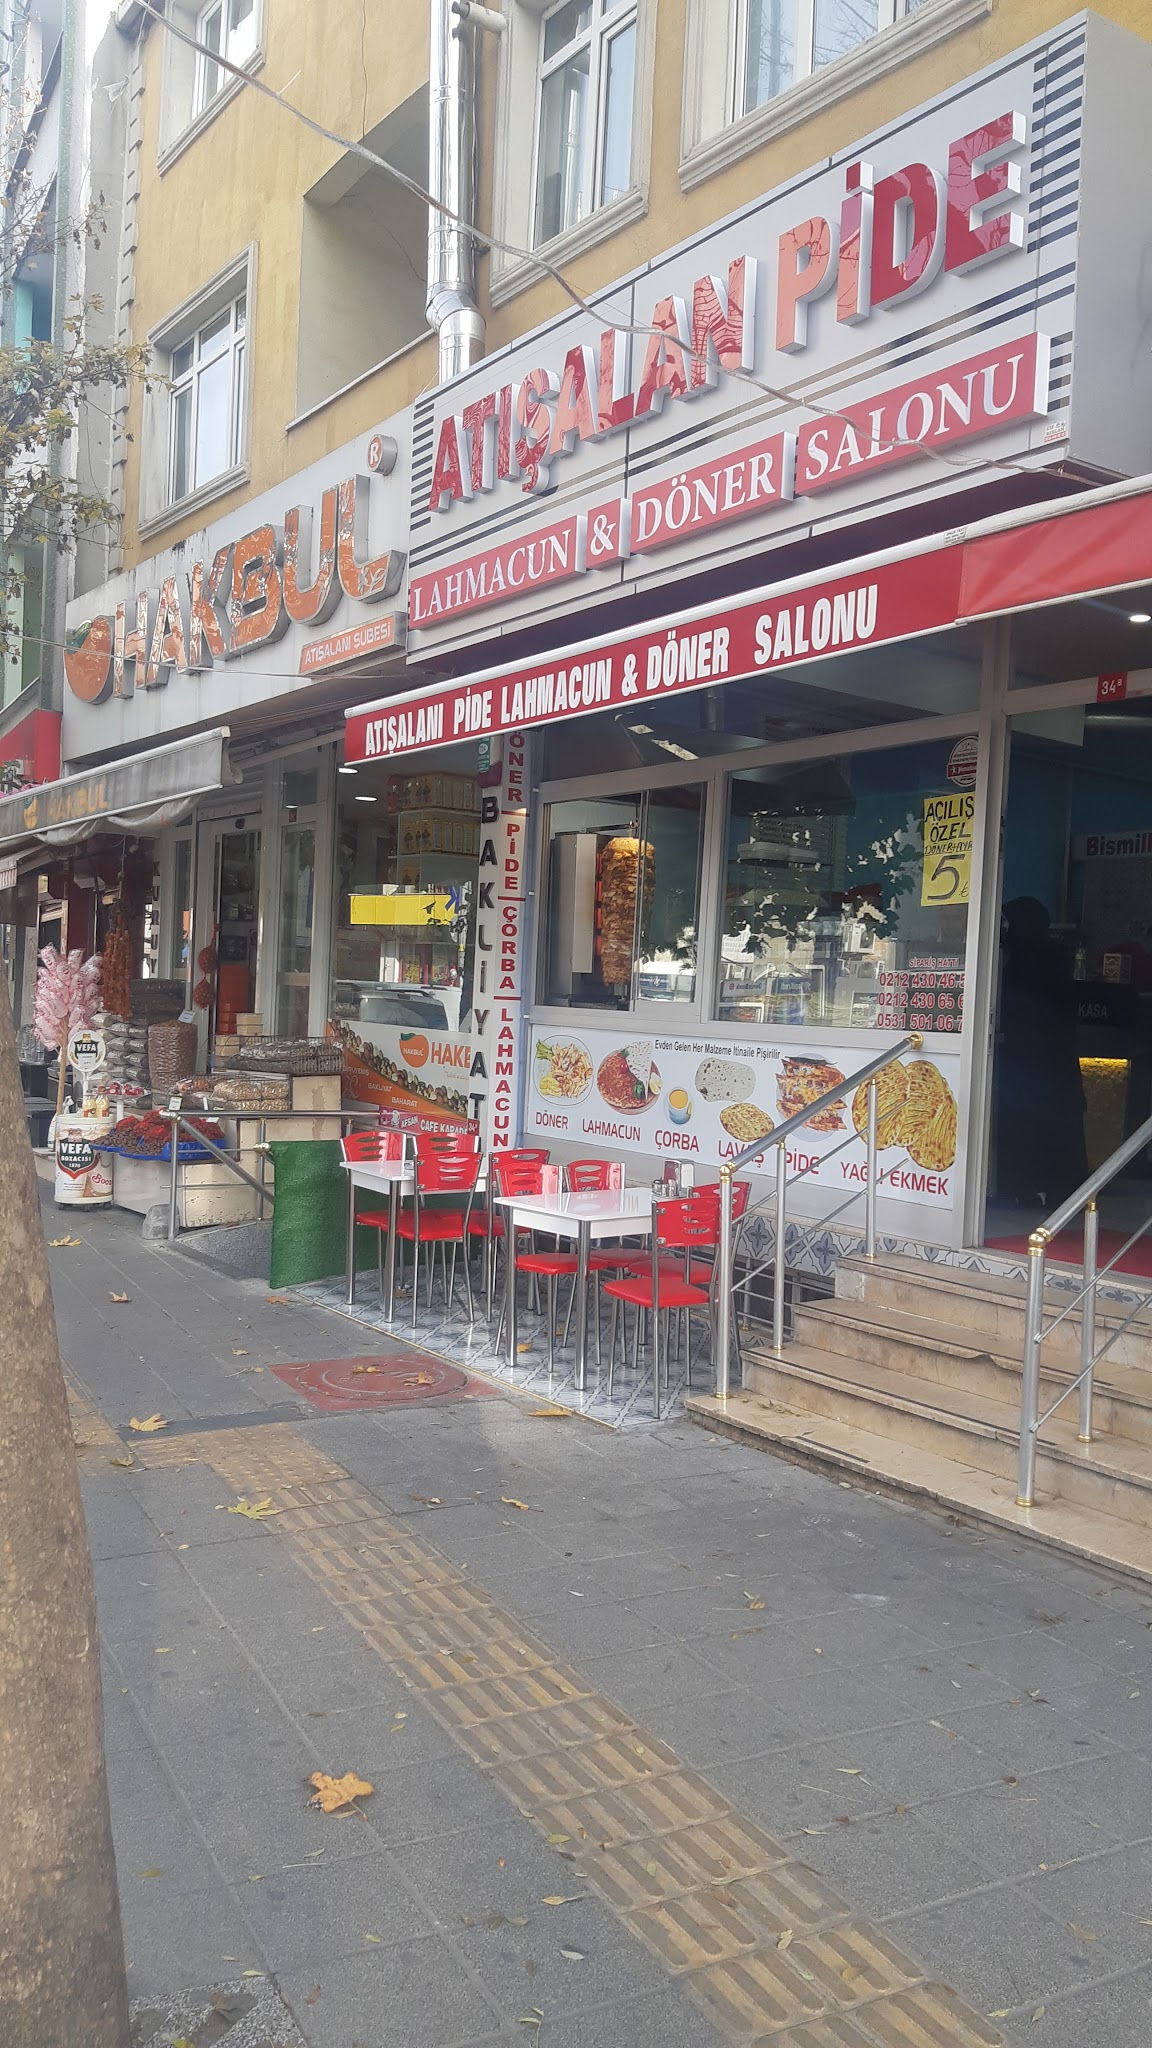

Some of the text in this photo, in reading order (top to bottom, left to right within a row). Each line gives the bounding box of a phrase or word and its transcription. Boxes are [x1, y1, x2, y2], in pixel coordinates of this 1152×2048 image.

[428, 110, 1026, 512] ATIŞALAN PİDE
[413, 354, 1025, 621] LAHMACUN & DÖNER SALONU
[113, 474, 405, 699] HAKBUL
[304, 635, 352, 665] ATIŞALANI
[365, 703, 444, 756] ATIŞALANI
[453, 687, 494, 735] PİDE
[501, 658, 612, 724] LAHMACUN
[621, 655, 639, 694] &
[646, 626, 730, 691] DÖNER
[754, 584, 878, 665] SALONU
[925, 796, 974, 822] AÇILIŞ
[929, 821, 972, 843] ÖZEL
[504, 823, 521, 890] PİDE
[927, 854, 965, 900] 5
[469, 796, 500, 1119] BAKLİYAT
[500, 906, 518, 990] ÇORBA
[909, 956, 936, 969] SİPARİŞ
[879, 972, 909, 987] 0212
[912, 972, 936, 988] 430
[939, 973, 955, 988] 46
[878, 992, 907, 1007] 0212
[911, 992, 935, 1008] 430
[938, 993, 954, 1009] 65
[1077, 1002, 1108, 1017] KASA
[877, 1012, 906, 1028] 0531
[910, 1014, 933, 1029] 501
[937, 1015, 953, 1031] 06
[76, 1043, 97, 1052] VEFA
[655, 1039, 673, 1050] Evden
[674, 1041, 692, 1052] Gelen
[692, 1042, 703, 1053] Her
[704, 1043, 731, 1056] Malzeme
[756, 1047, 781, 1060] Pişirilir
[492, 1007, 514, 1147] LAHMACUN
[420, 1119, 439, 1133] CAFE
[60, 1142, 92, 1154] VEFA
[535, 1110, 569, 1130] DÖNER
[582, 1118, 641, 1142] LAHMACUN
[655, 1129, 700, 1153] ÇORBA
[718, 1140, 764, 1168] LAVŞ
[840, 1160, 883, 1185] YAĞI
[889, 1170, 949, 1196] EKMEK
